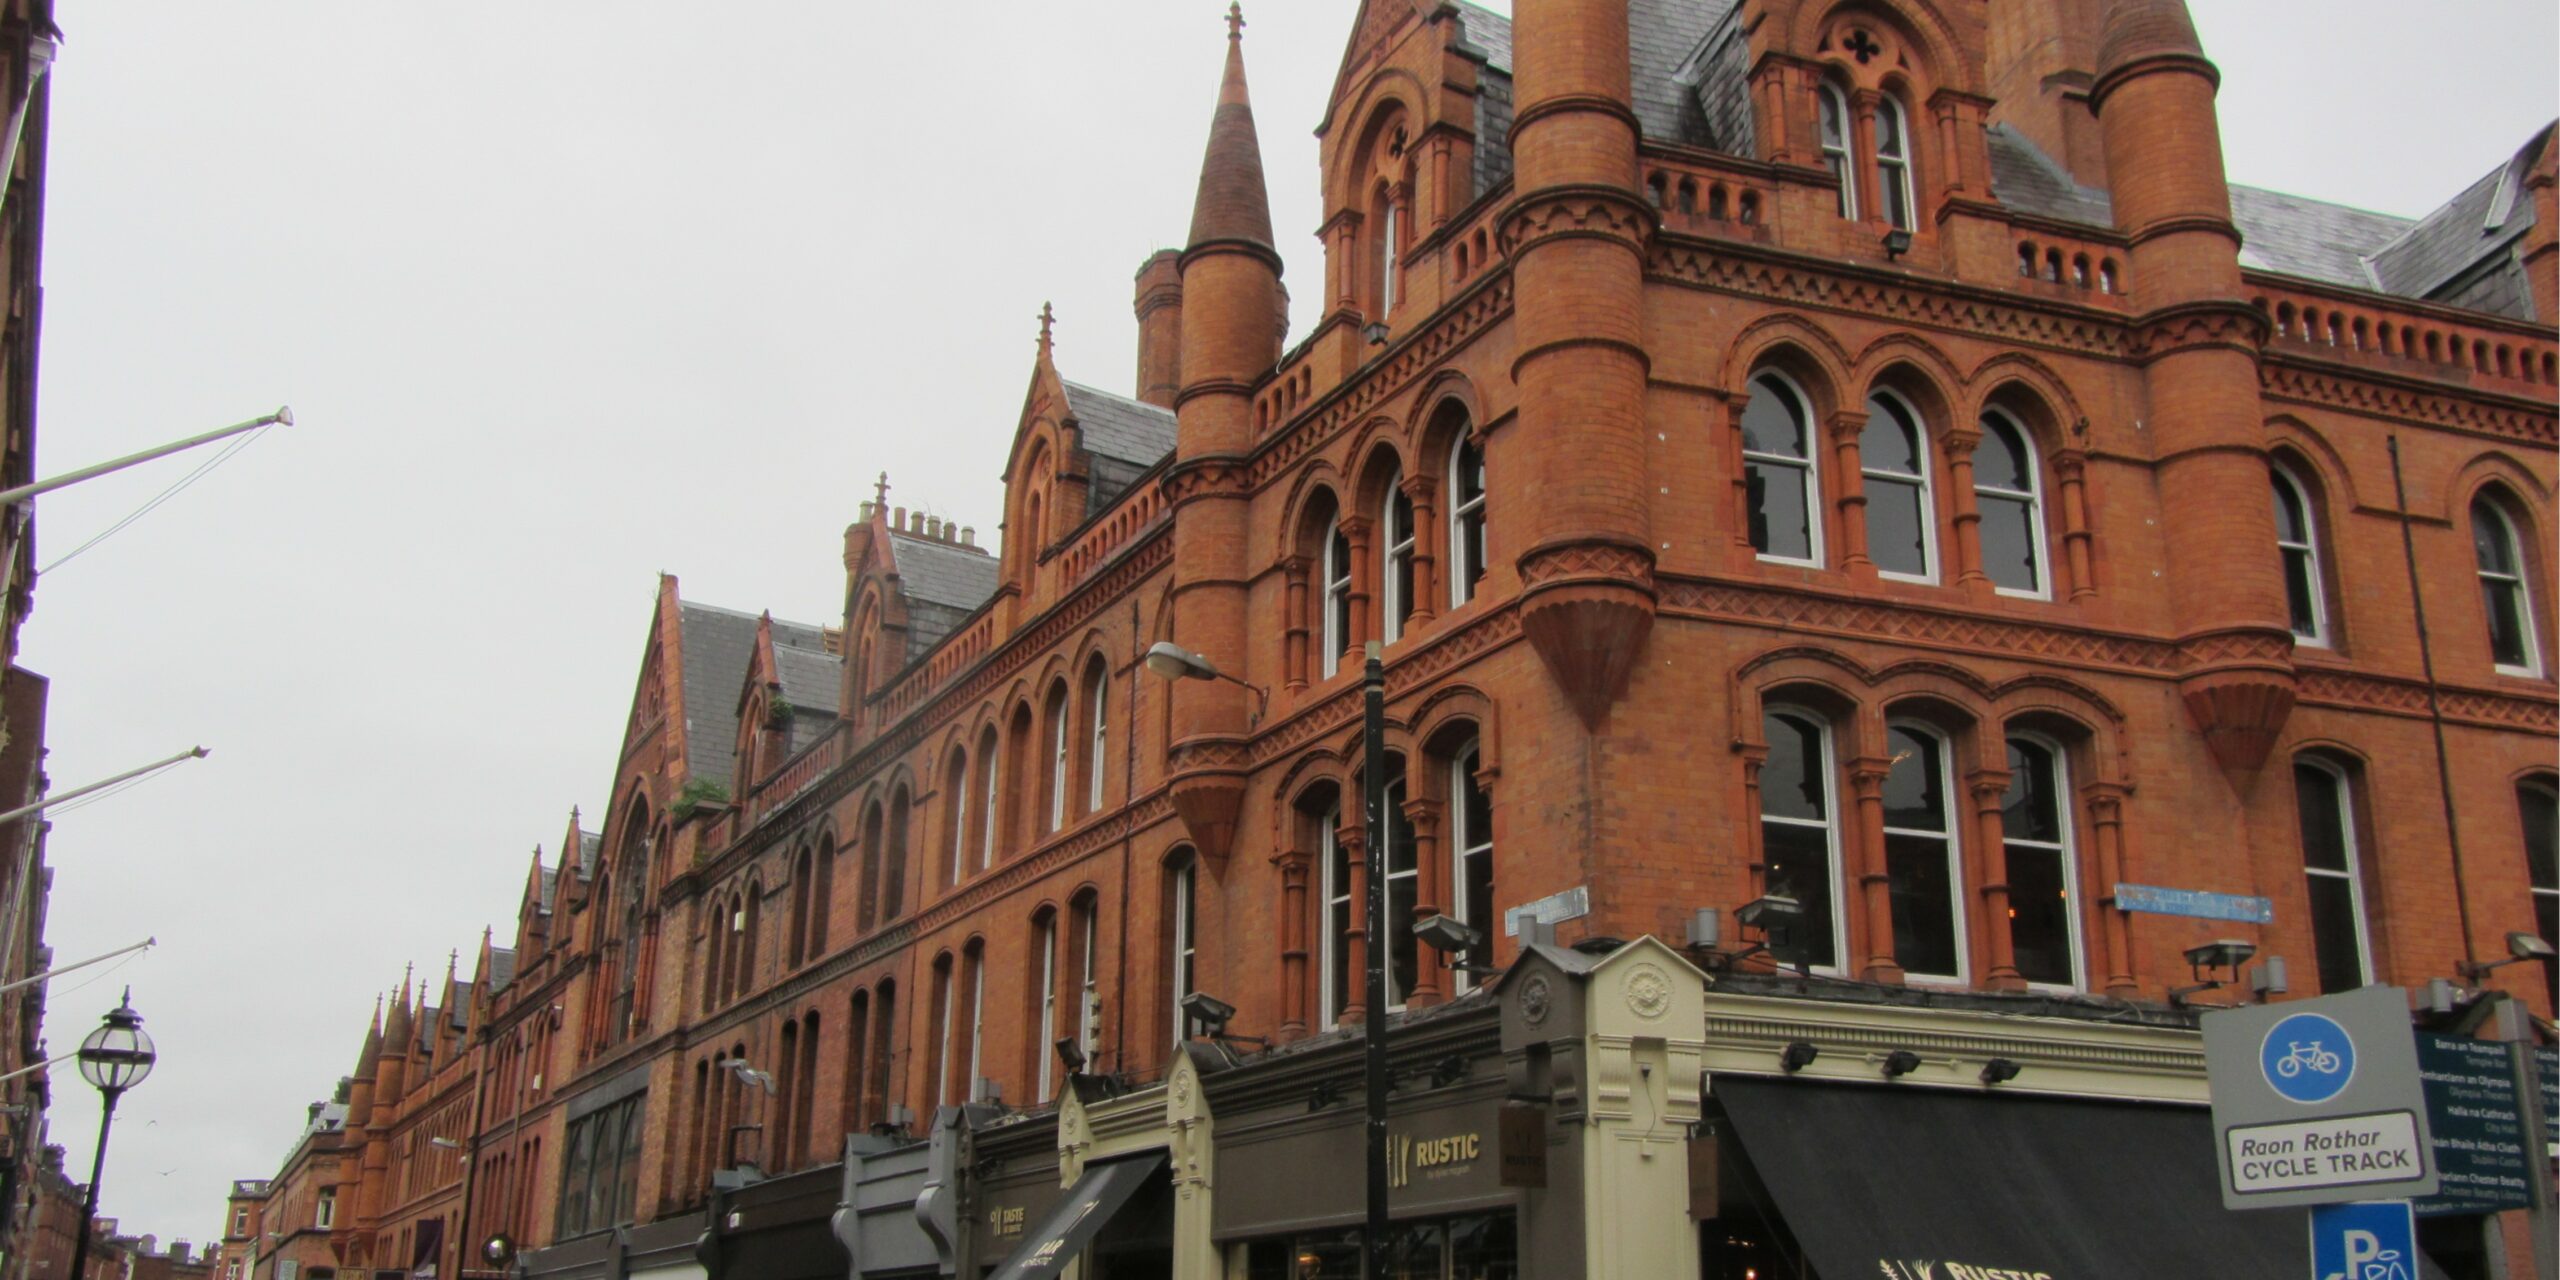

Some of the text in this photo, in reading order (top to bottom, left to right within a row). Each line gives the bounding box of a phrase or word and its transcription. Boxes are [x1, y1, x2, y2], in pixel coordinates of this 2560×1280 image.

[2435, 1040, 2457, 1051] Barra
[2458, 1044, 2469, 1052] an
[2466, 1056, 2507, 1069] Temple Bar
[2467, 1077, 2478, 1085] an
[2479, 1076, 2511, 1088] Olympia
[2449, 1087, 2482, 1099] Olympia
[2470, 1110, 2480, 1118] na
[2481, 1109, 2517, 1121] Cathrach
[1416, 1133, 1479, 1167] RUSTIC
[2241, 1130, 2381, 1157] Raon Rothar
[2243, 1149, 2410, 1180] CYCLE TRACK
[2469, 1174, 2499, 1185] Chester
[2501, 1176, 2526, 1189] Beatty
[2343, 1229, 2379, 1280] P
